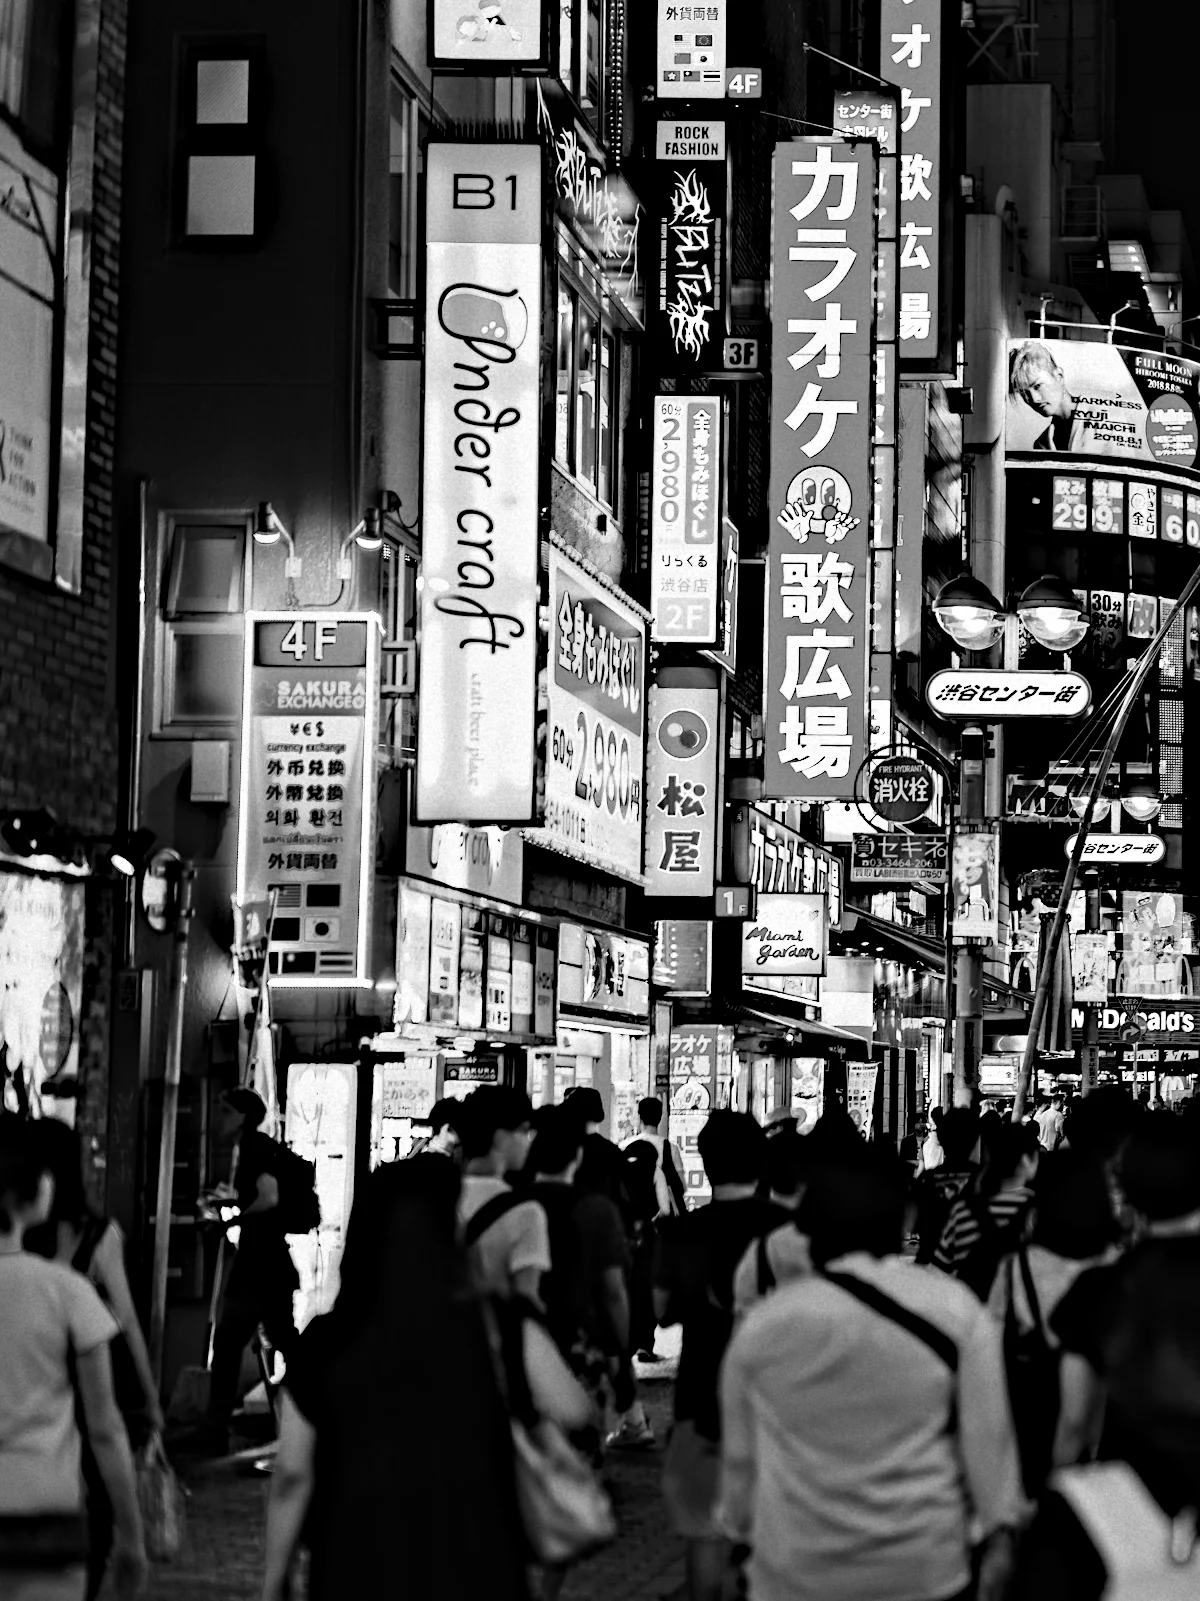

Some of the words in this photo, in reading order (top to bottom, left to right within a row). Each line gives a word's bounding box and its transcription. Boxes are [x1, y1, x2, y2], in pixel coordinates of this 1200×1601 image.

[666, 7, 719, 21] 外貨両替
[728, 74, 759, 94] 4F
[838, 104, 893, 120] センター街
[675, 126, 710, 139] ROCK
[665, 142, 719, 156] FASHION
[891, 0, 933, 341] オケ歌広場
[452, 173, 518, 211] B1
[729, 343, 755, 365] 3F
[1135, 356, 1164, 371] FULL
[1165, 361, 1192, 378] MOON
[437, 281, 521, 488] Under
[1135, 367, 1169, 380] HIROOMI
[1170, 374, 1193, 387] TOSAKA
[1071, 396, 1143, 411] DARKNESS
[1084, 421, 1136, 434] IMAICHI
[1094, 433, 1143, 445] 2018.8.1
[1146, 488, 1156, 535] やきとり
[661, 555, 708, 568] りらくる
[434, 508, 525, 654] craft
[661, 578, 708, 593] 渋谷店
[1092, 594, 1122, 612] 30分
[666, 604, 703, 630] 2F
[281, 621, 338, 661] 4F
[278, 681, 365, 696] SAKURA
[936, 684, 1082, 703] 渋谷センター街
[894, 765, 923, 773] HYDRANT
[873, 776, 930, 804] 消火栓
[656, 775, 706, 873] 松屋
[877, 836, 947, 858] セキネ
[268, 853, 337, 870] 外貨両替
[869, 859, 938, 868] 03-3464-2061
[723, 890, 746, 915] 1F
[745, 927, 803, 942] Miami
